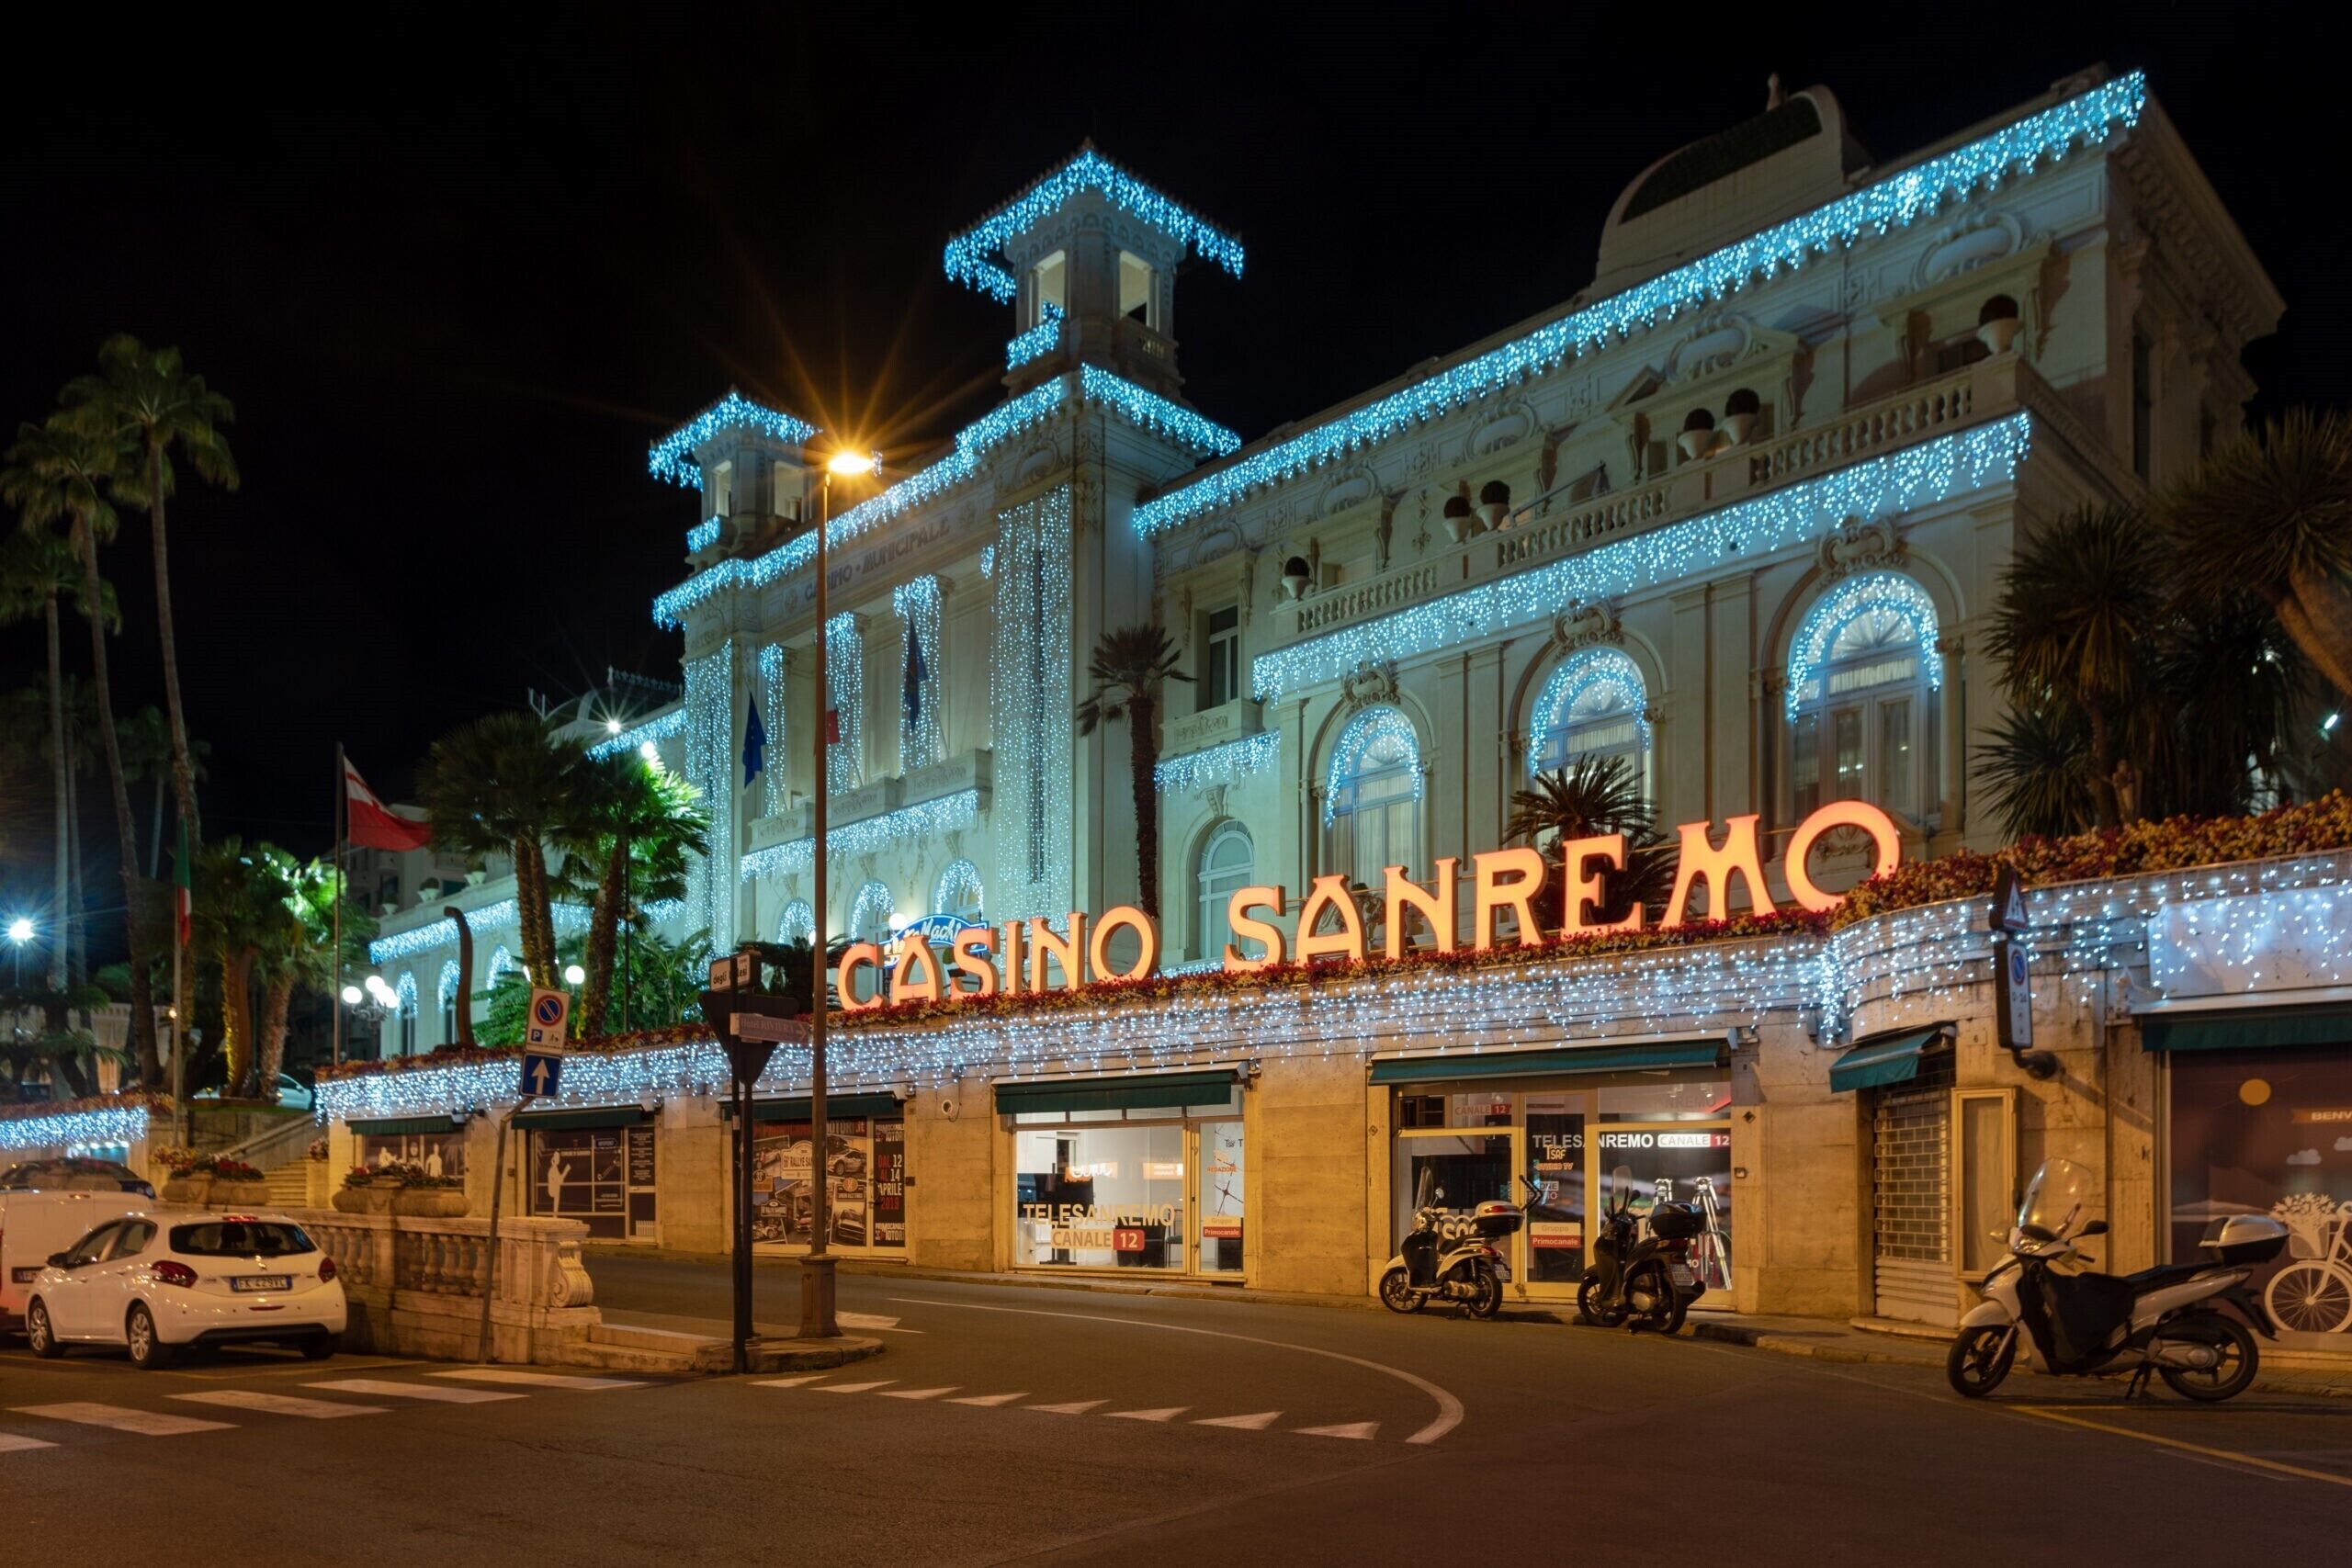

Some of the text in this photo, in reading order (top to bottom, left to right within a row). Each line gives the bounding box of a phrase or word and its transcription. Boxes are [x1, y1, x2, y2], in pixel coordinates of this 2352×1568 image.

[862, 517, 950, 574] MUNICIPALE
[837, 799, 1901, 1011] CASINO SANREMO
[1455, 1105, 1506, 1116] CANALE 12
[2311, 1111, 2352, 1121] BENV
[1659, 1134, 1709, 1146] CANALE
[1714, 1134, 1730, 1146] 12
[892, 1154, 902, 1168] 12
[889, 1168, 900, 1182] 14
[877, 1182, 902, 1196] APRILE
[1023, 1203, 1176, 1227] TELESANREMO
[1204, 1227, 1239, 1236] Primocanale
[1542, 1224, 1569, 1233] Gruppo
[1051, 1231, 1138, 1248] CANALE 12
[1532, 1236, 1579, 1247] Primocanale
